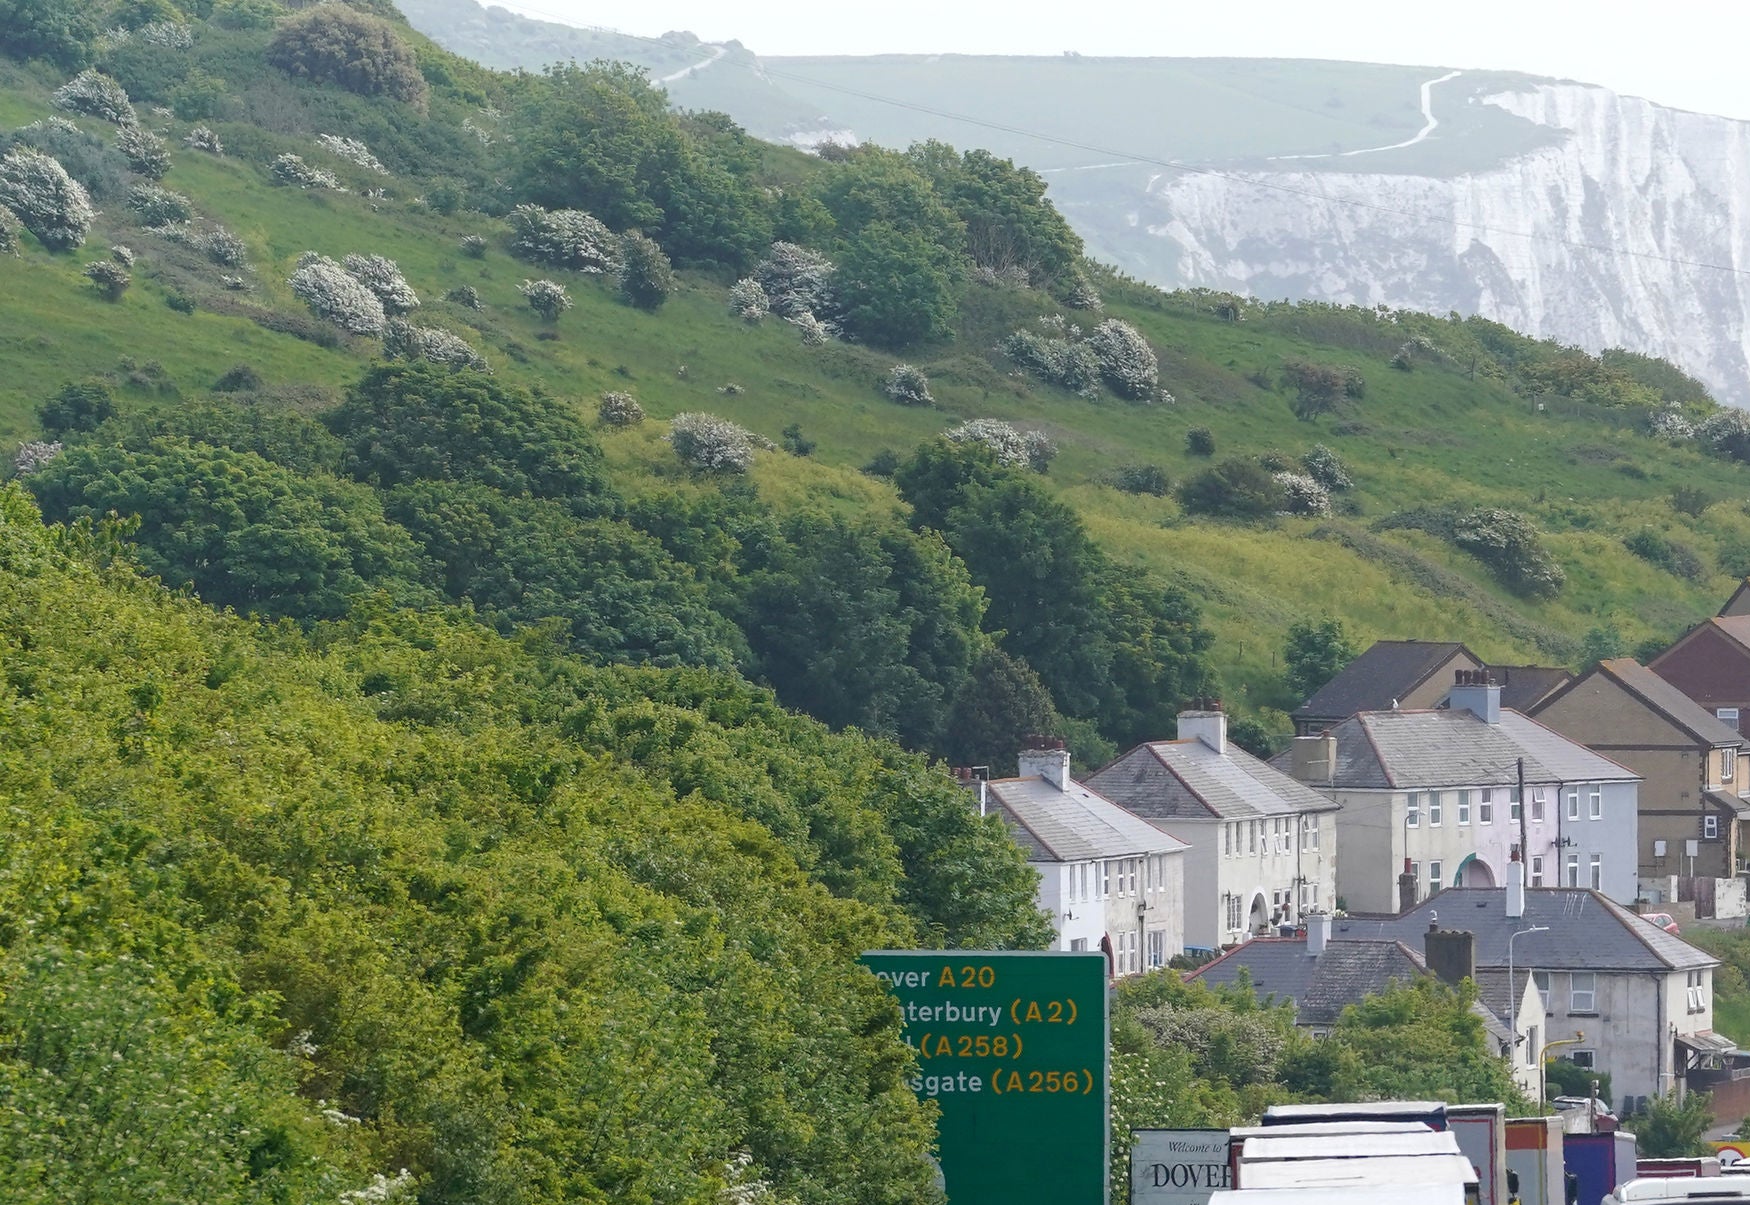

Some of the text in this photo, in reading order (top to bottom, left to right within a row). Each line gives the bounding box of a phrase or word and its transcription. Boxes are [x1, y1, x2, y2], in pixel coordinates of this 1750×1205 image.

[877, 966, 995, 988] over A20
[896, 998, 1078, 1027] nterbury (A2)
[921, 1032, 1023, 1060] (A258)
[910, 1068, 1094, 1096] sgate (A256)
[1169, 1141, 1223, 1153] Welcome to
